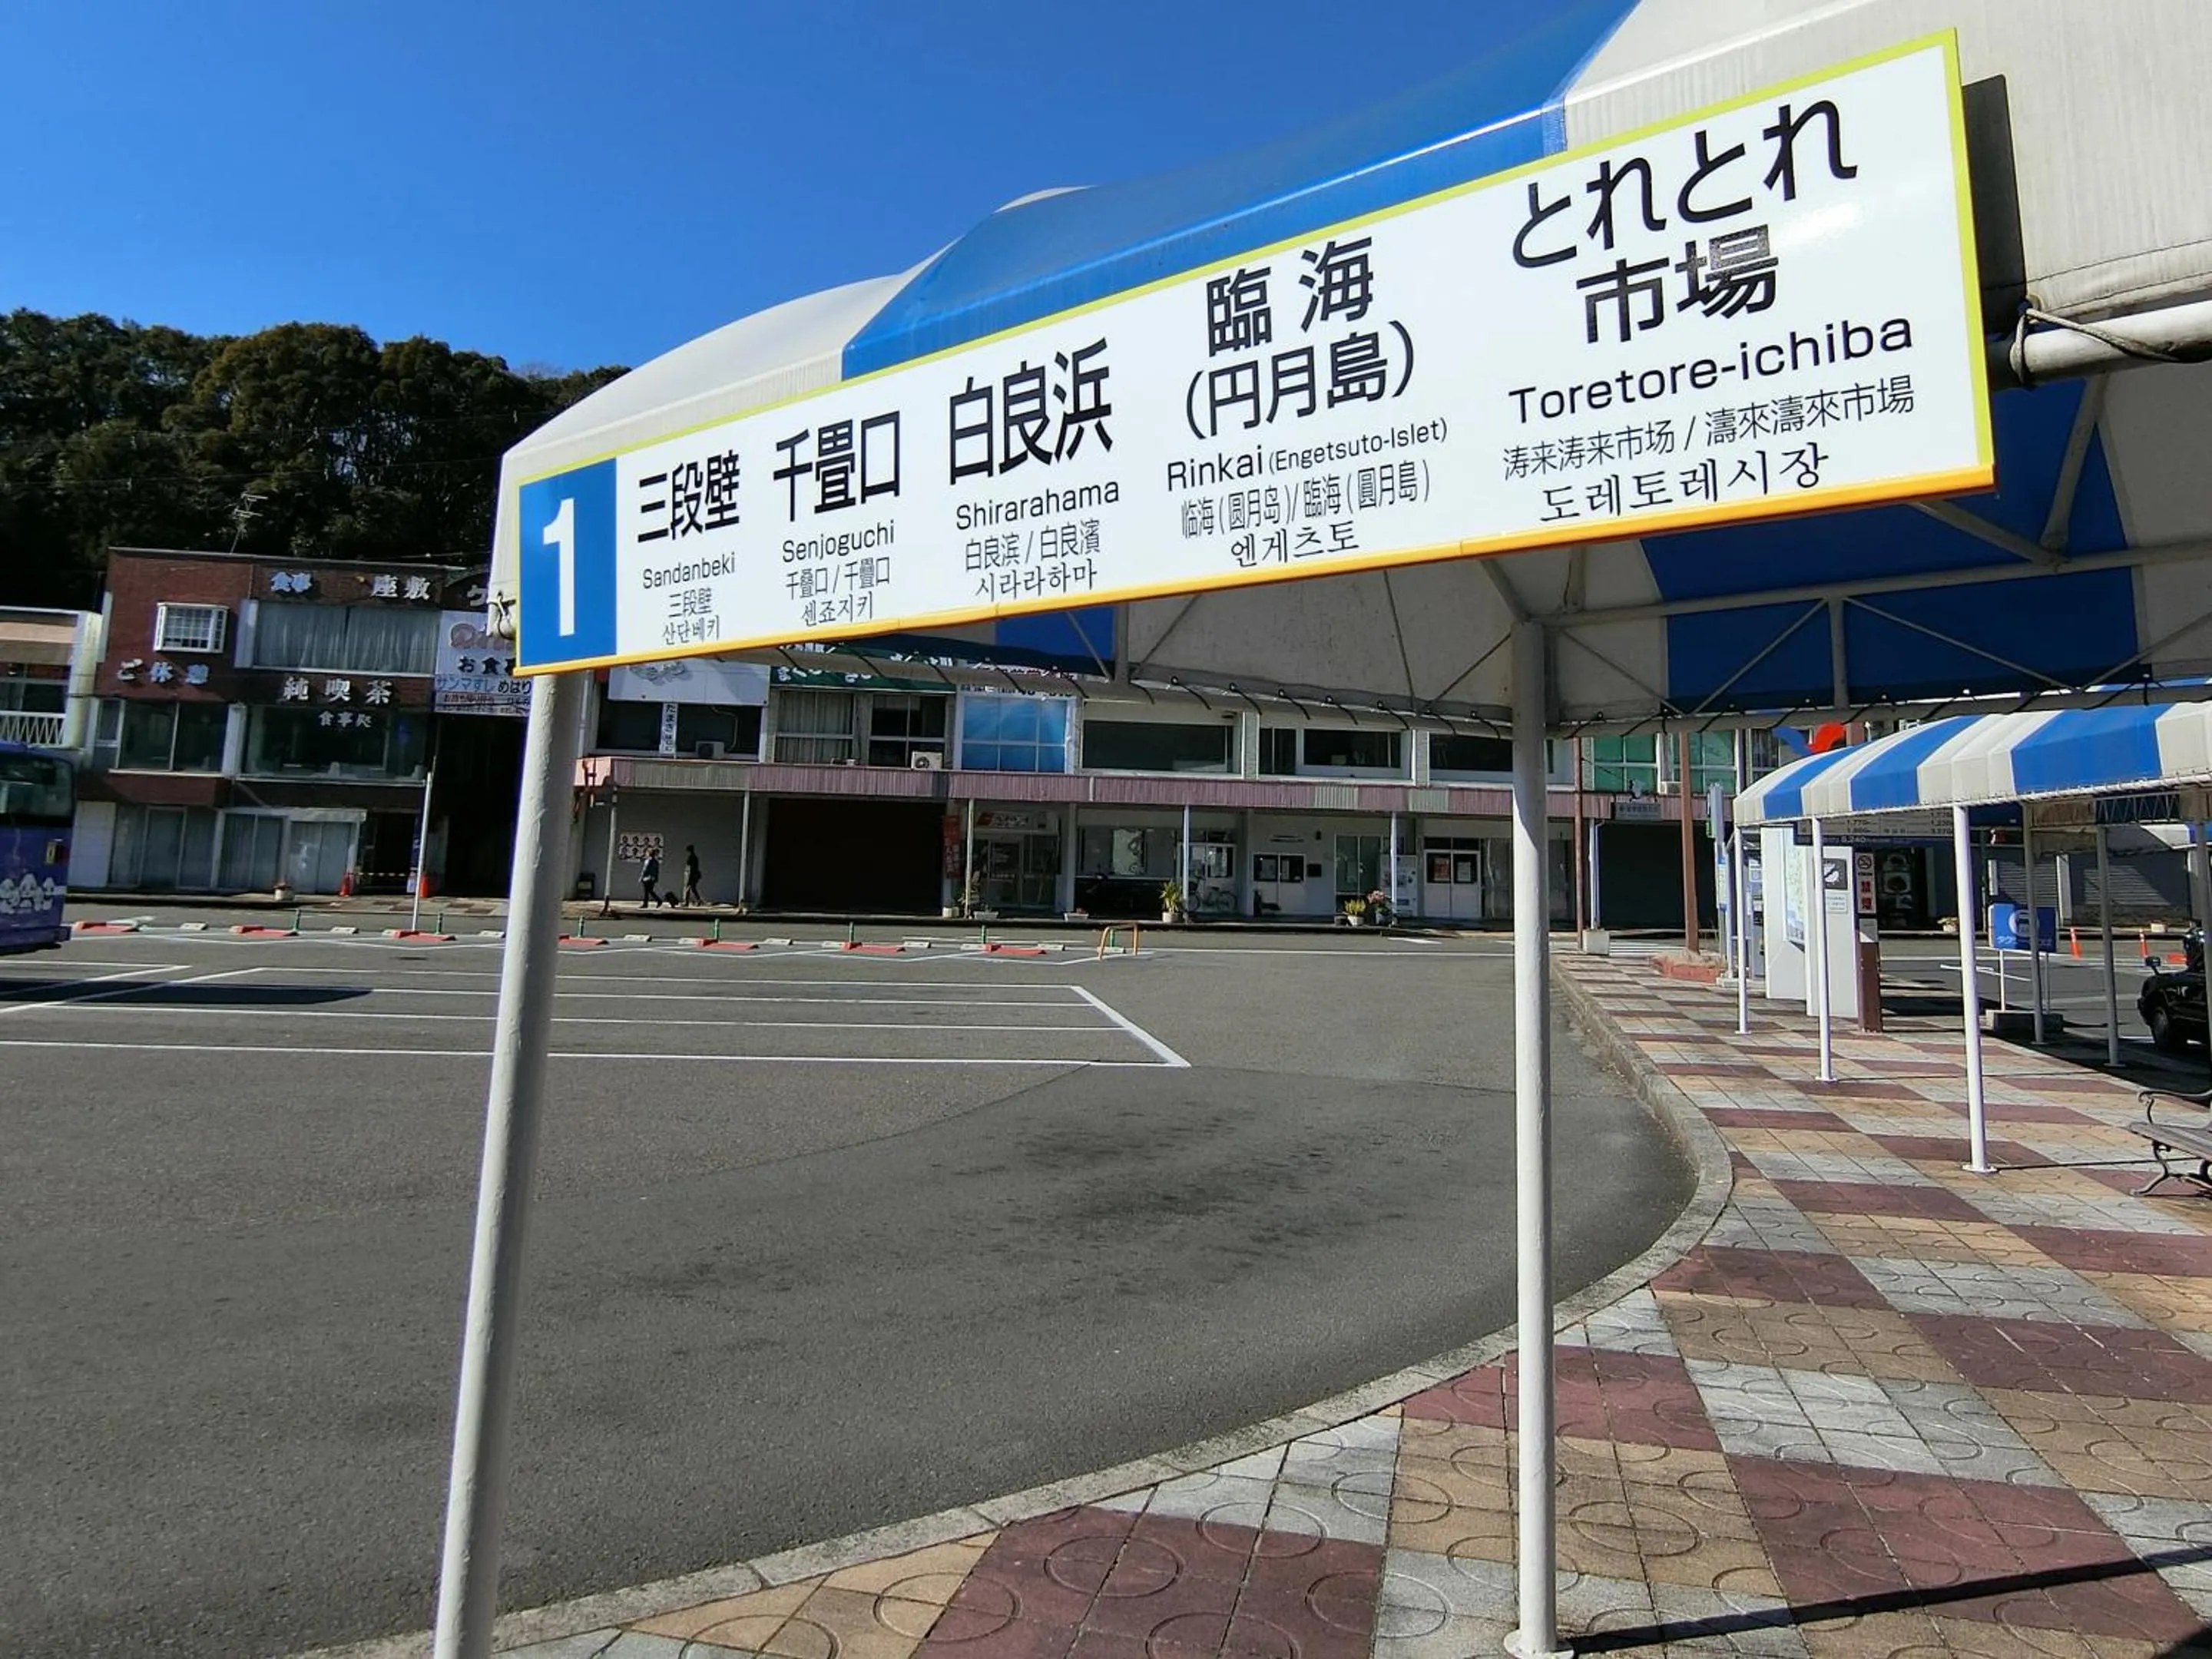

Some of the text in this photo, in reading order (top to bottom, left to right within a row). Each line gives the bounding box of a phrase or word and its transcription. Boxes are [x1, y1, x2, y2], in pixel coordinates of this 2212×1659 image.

[1513, 100, 1858, 268] とれとれ
[1207, 237, 1373, 357] 臨海
[1576, 224, 1779, 344] 市場
[1187, 320, 1413, 439] (円月島)
[1508, 319, 1912, 423] Toretore-ichiba
[950, 337, 1113, 485] 白良浜
[1168, 418, 1447, 492] Rinkai (Engetsuto-Islet)
[1541, 442, 1829, 522] 도레토레시장
[637, 449, 740, 543] 三段壁
[957, 482, 1118, 530] Shirarahama
[543, 498, 575, 637] 1
[644, 552, 734, 589] Sandanbeki
[783, 520, 893, 562] Senjoguchi
[1231, 521, 1359, 567] 엔게츠토
[669, 588, 711, 618] 三段壁
[803, 591, 872, 627] 센죠지키
[977, 558, 1097, 601] 시라라하마
[284, 677, 392, 705] 純喫茶
[319, 710, 373, 728] 食事処
